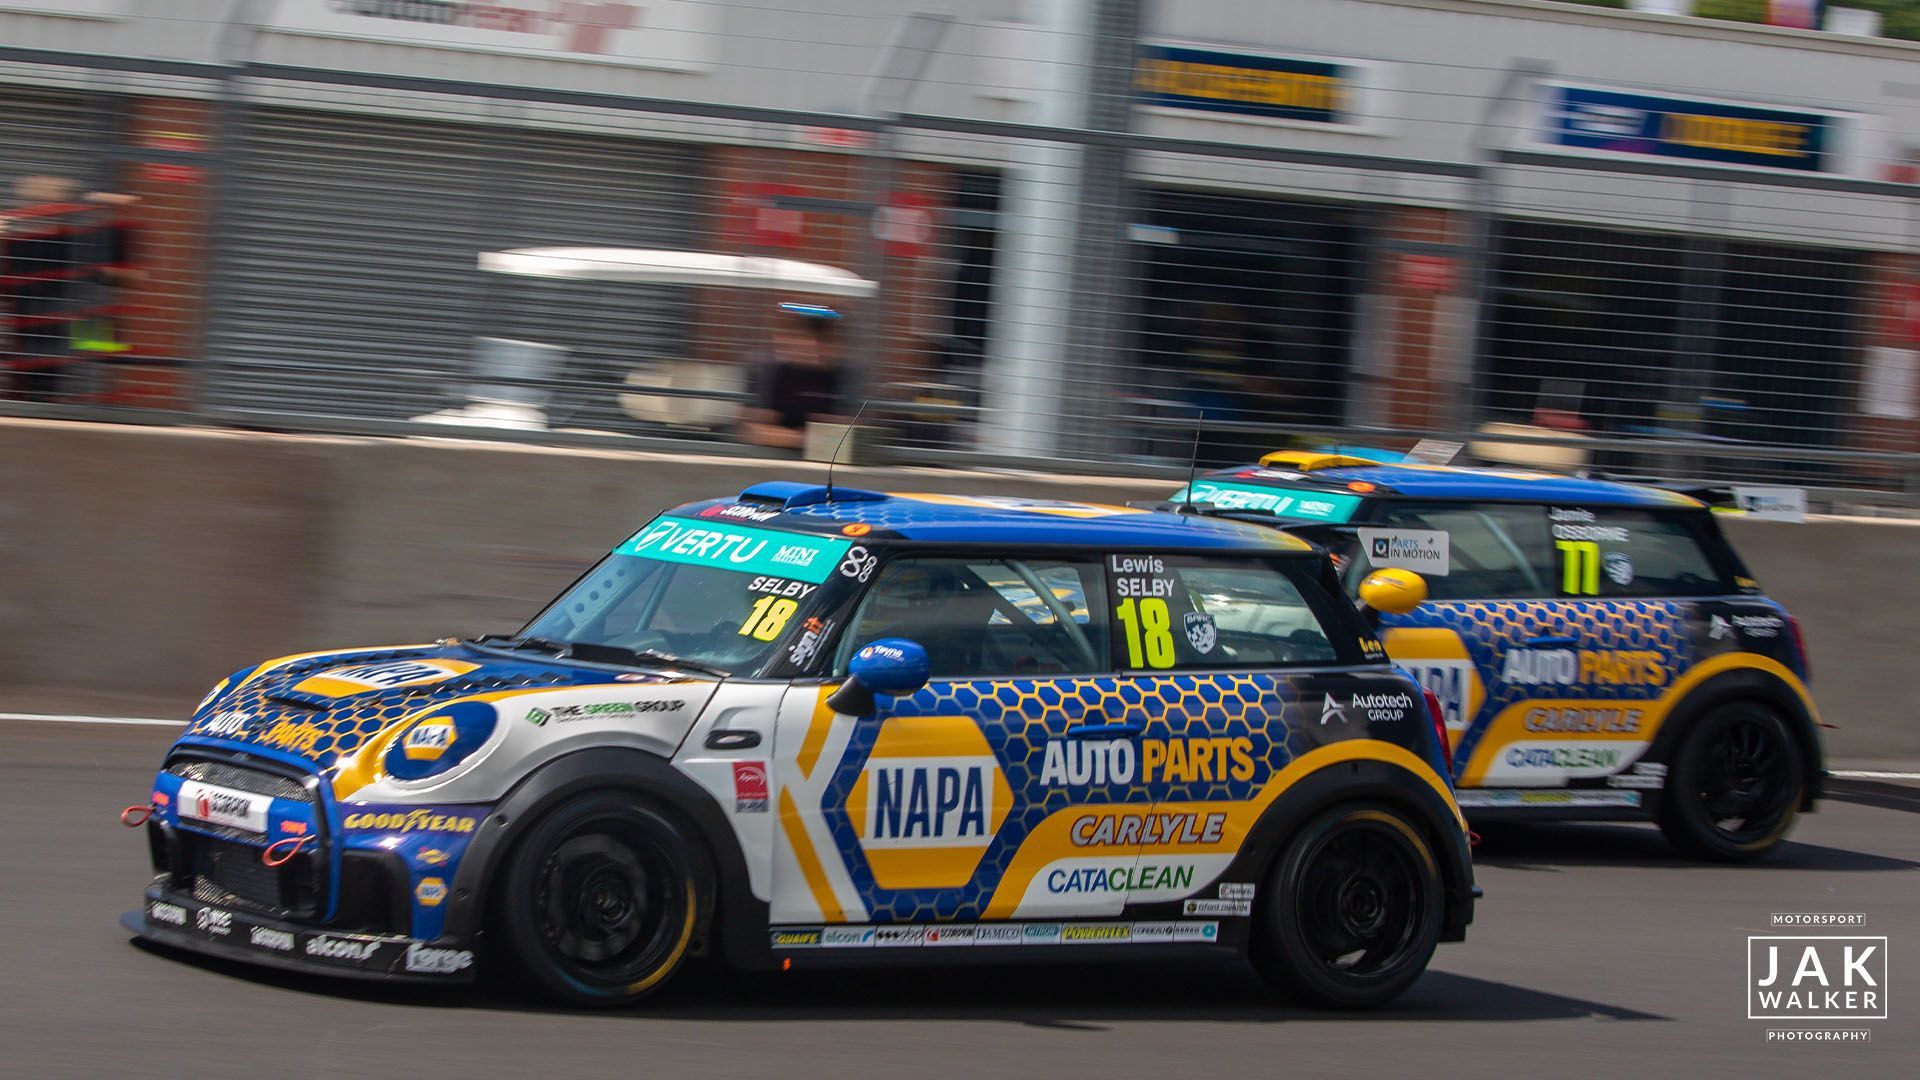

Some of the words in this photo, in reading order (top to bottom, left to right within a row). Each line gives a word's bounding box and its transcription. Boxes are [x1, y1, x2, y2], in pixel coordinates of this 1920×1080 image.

[665, 525, 769, 563] VERTU
[776, 544, 820, 562] MINI
[1390, 549, 1400, 558] IN
[1402, 549, 1440, 560] MOTION
[1391, 539, 1419, 549] PARTS
[1112, 555, 1165, 574] Lewis
[1555, 540, 1600, 595] 11
[747, 576, 817, 600] SELBY
[1116, 577, 1175, 598] SELBY
[738, 596, 800, 643] 18
[1116, 597, 1176, 669] 18
[1502, 648, 1577, 685] AUTO
[1578, 650, 1667, 686] PARTS
[634, 699, 685, 713] GROUP
[1352, 692, 1413, 709] Autotech
[1368, 709, 1404, 721] GROUP
[1523, 707, 1644, 733] CARLYLE
[1039, 739, 1135, 786] AUTO
[1142, 737, 1255, 783] PARTS
[874, 765, 985, 840] NAPA
[343, 808, 477, 833] GOODYEAR
[1071, 812, 1228, 847] CARLYLE
[1047, 865, 1195, 894] CATACLEAN
[826, 931, 860, 943] alcon
